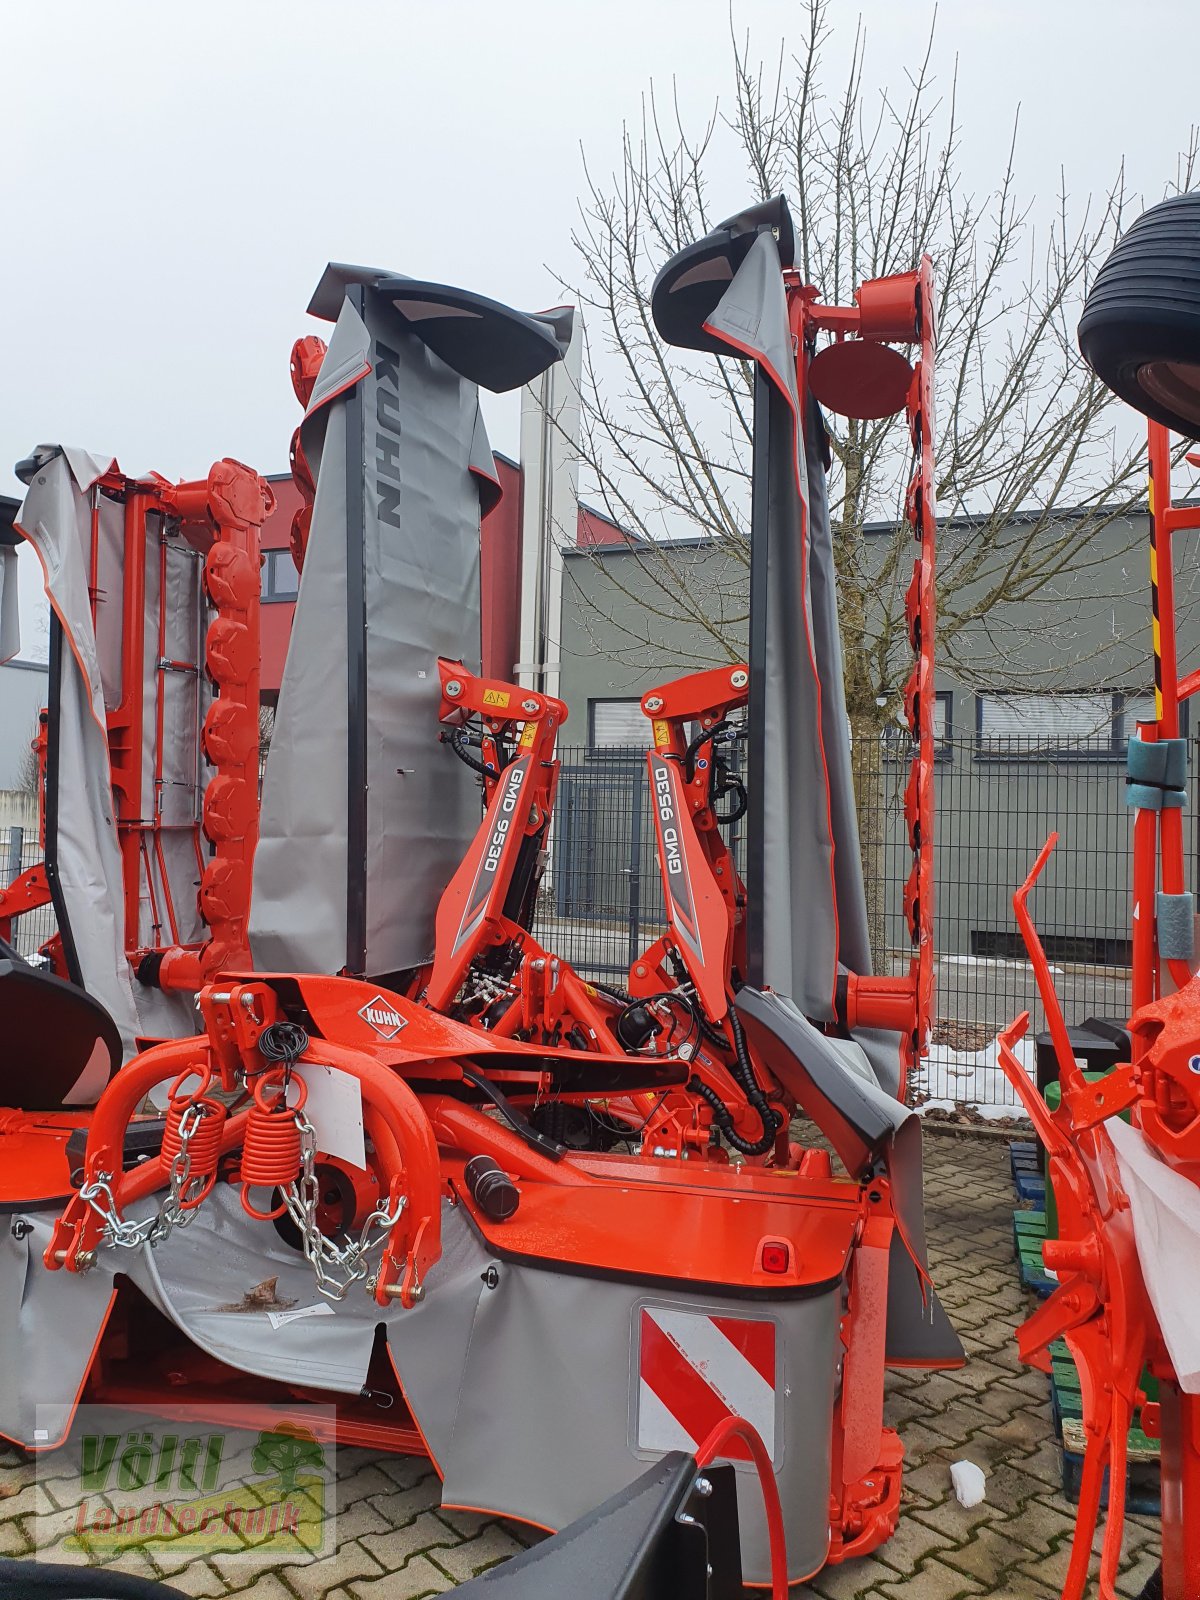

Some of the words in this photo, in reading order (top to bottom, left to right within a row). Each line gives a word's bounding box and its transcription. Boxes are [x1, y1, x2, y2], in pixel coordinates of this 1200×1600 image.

[376, 340, 401, 528] KUHN
[502, 769, 524, 812] GMD
[655, 767, 673, 820] 9530
[485, 820, 509, 872] 9530
[664, 828, 682, 874] GMD
[366, 1007, 402, 1027] KUHN
